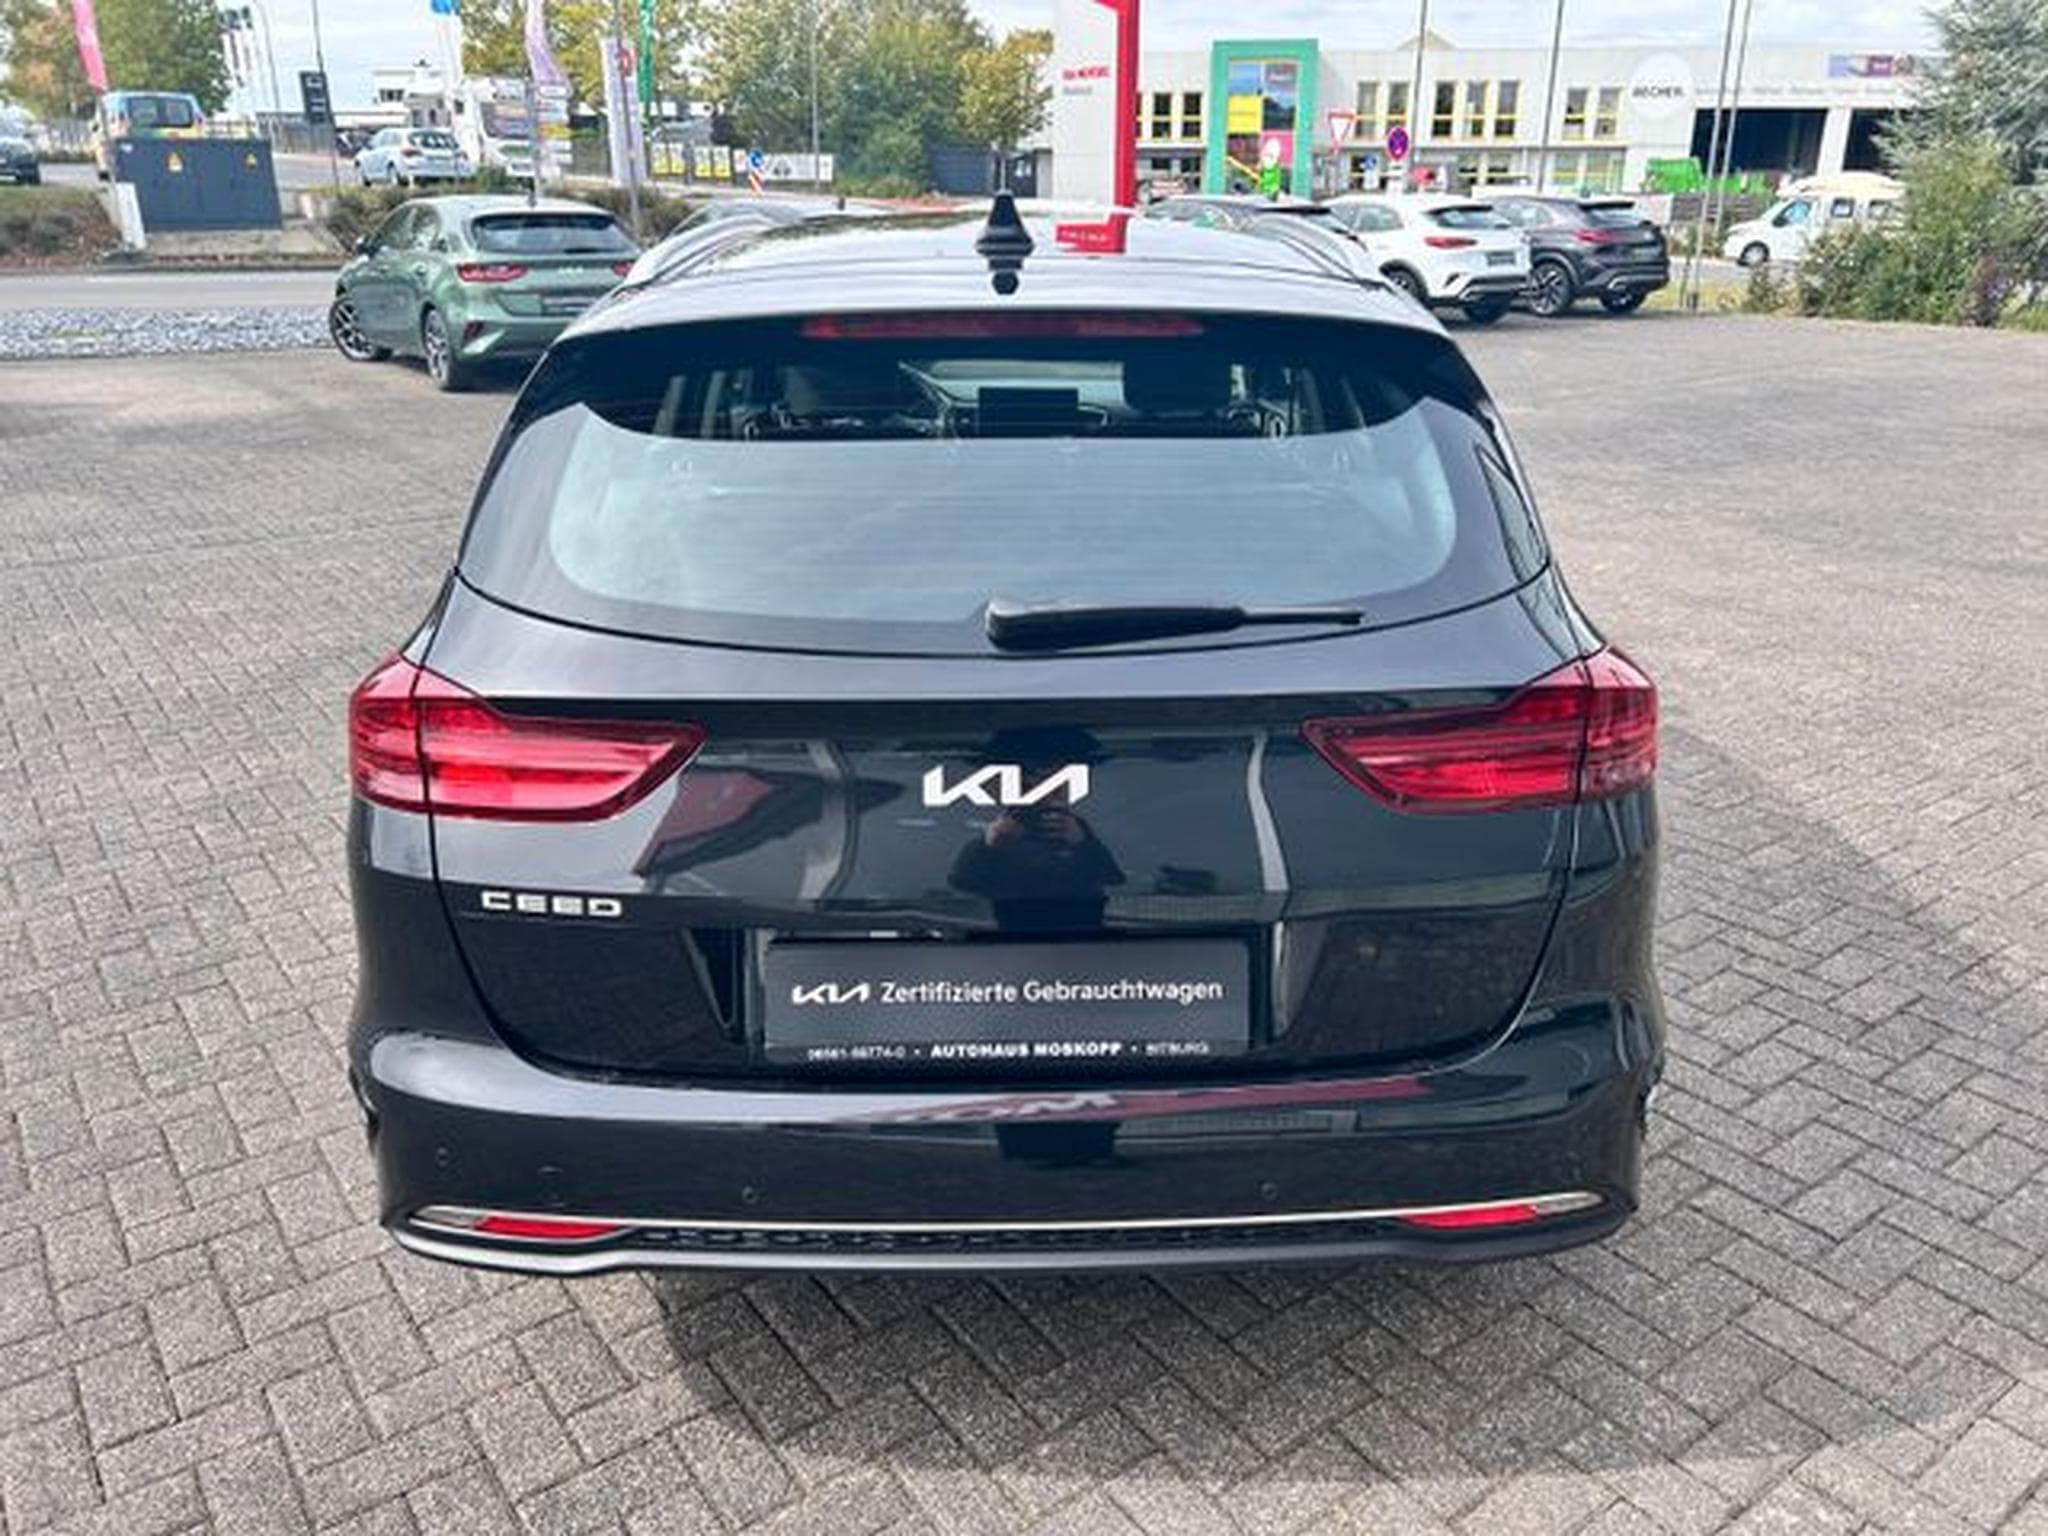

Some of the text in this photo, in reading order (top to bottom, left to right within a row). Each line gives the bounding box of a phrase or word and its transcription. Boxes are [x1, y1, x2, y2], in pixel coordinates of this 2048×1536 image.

[923, 764, 1089, 806] KIA
[478, 890, 621, 917] CEED
[792, 979, 1224, 1005] KIA Zertifizierte Gebrauchtwagen
[930, 1043, 1029, 1059] AUTOHAUS
[1033, 1041, 1122, 1057] MOSKOPP
